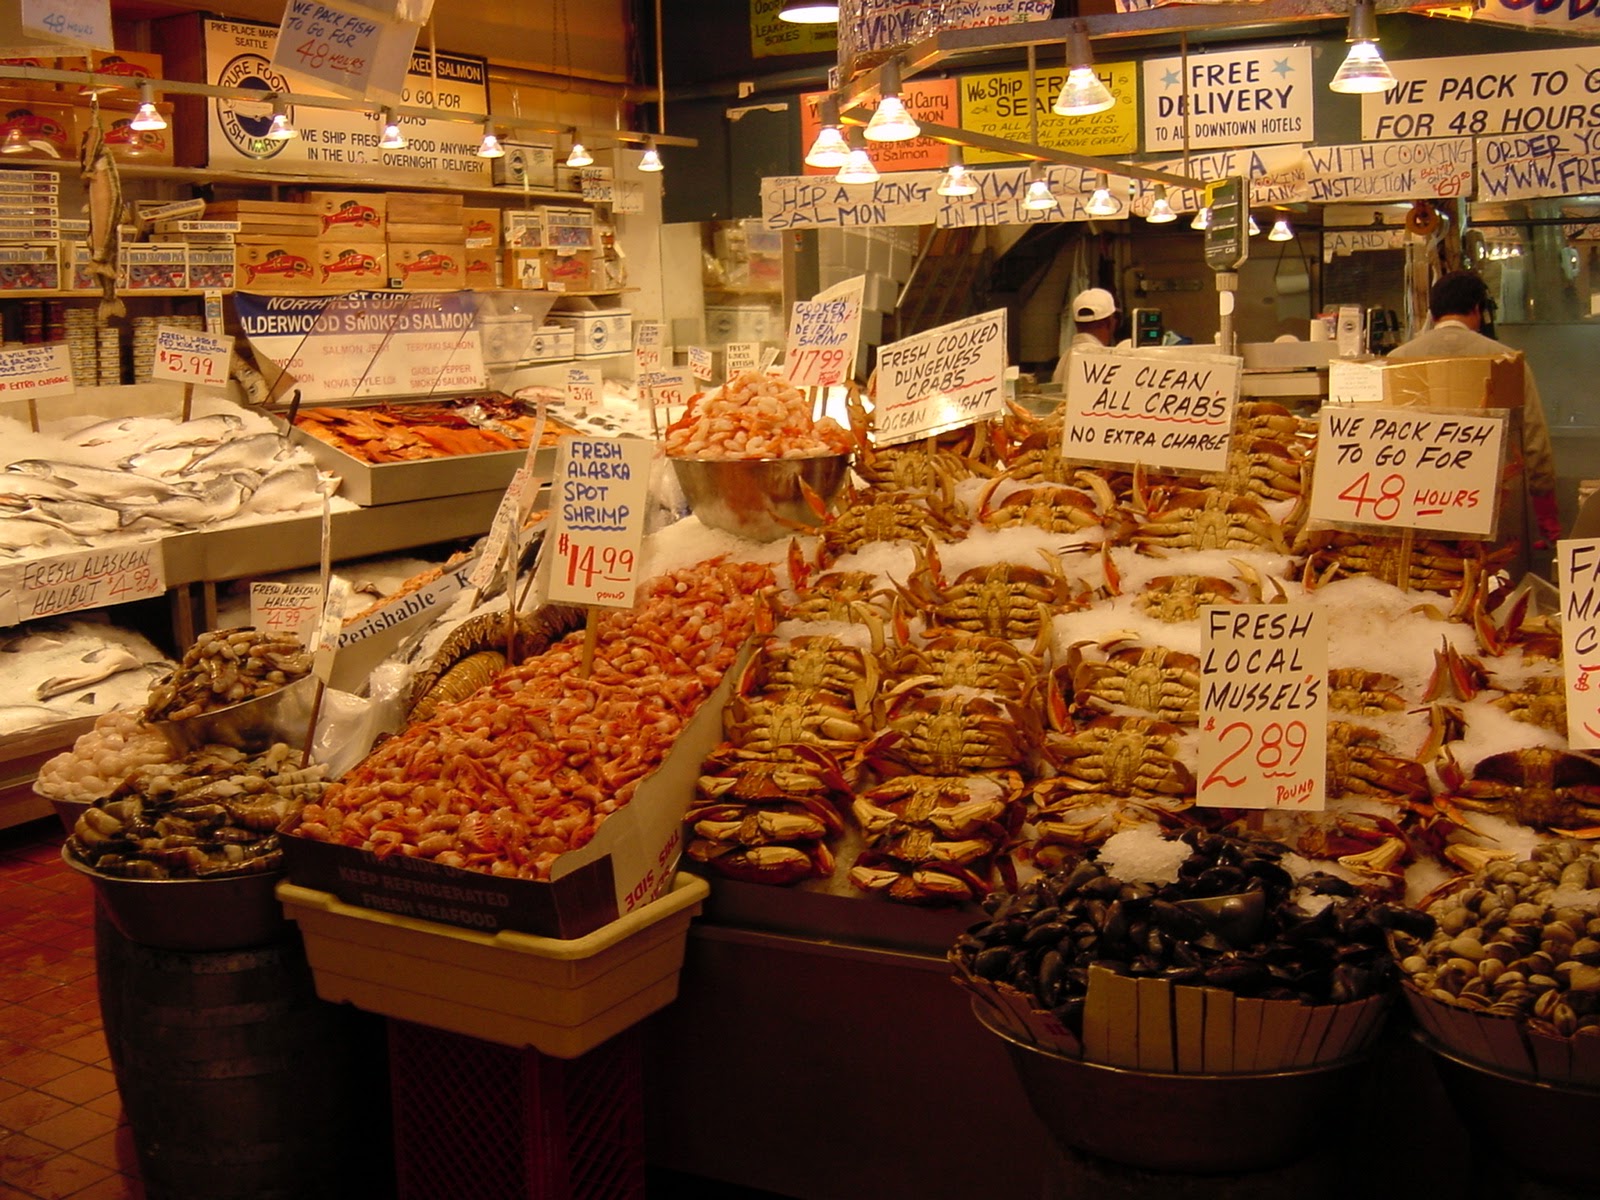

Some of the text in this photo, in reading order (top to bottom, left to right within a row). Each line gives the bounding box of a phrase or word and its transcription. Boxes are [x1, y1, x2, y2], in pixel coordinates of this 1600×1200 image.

[43, 13, 93, 35] 48 HOURS
[211, 21, 279, 39] PIKE PLACE MARK
[293, 0, 376, 36] WE PACK FISH
[235, 36, 268, 50] SEATTLE
[287, 17, 357, 48] TO GO FOR
[296, 38, 365, 69] 48 HOURS
[223, 60, 251, 88] PURE
[437, 61, 480, 81] SALMON
[1192, 60, 1260, 88] FREE
[415, 89, 461, 108] GO FOR
[967, 78, 1023, 103] We Ship
[1384, 80, 1427, 105] WE
[1439, 74, 1517, 101] PACK
[1531, 70, 1569, 96] TO
[916, 91, 949, 114] Carry
[1158, 85, 1294, 118] DELIVERY
[223, 109, 246, 145] FISH
[300, 128, 317, 142] WE
[322, 129, 346, 144] SHIP
[982, 123, 996, 133] TO
[1000, 122, 1021, 132] ALL
[1058, 125, 1119, 137] EXPRESS
[1155, 117, 1302, 141] TO DOWNTOWN HOTELS
[1375, 113, 1434, 139] FOR
[1448, 109, 1489, 134] 48
[883, 149, 928, 163] Salmon
[1055, 137, 1090, 149] ARRIVE
[1486, 134, 1570, 165] ORDER
[308, 147, 318, 160] IN
[322, 148, 343, 162] THE
[383, 153, 438, 169] OVERNIGHT
[442, 158, 484, 172] DELIVERY
[1250, 151, 1267, 179] A
[1308, 140, 1472, 174] WITH COOKING
[769, 181, 932, 215] SHIP A KING
[768, 204, 887, 229] SALMON
[940, 201, 1010, 228] IN THE
[796, 302, 847, 314] COOKED
[160, 331, 186, 341] FRESH
[241, 312, 475, 334] ALDERWOOD SMOKED SALMON
[798, 333, 848, 346] SHRIMP
[880, 322, 999, 372] FRESH COOKED
[159, 350, 213, 376] $5.99
[894, 345, 984, 387] DUNGENESS
[1083, 360, 1212, 391] WE CLEAN
[1092, 387, 1131, 411] ALL
[881, 407, 927, 432] OCEAN
[1330, 415, 1495, 446] WE PACK FISH
[571, 441, 623, 461] FRESH
[1070, 426, 1230, 452] NO EXTRA CHARGE
[1337, 443, 1473, 469] TO GO FOR
[567, 460, 631, 480] ALASKA
[564, 481, 609, 502] SPOT
[1338, 472, 1480, 521] 48 HOURS
[563, 503, 631, 525] SHRIMP
[23, 549, 150, 589] FRESH ALASKAN
[31, 580, 102, 615] HALIBUT
[252, 583, 321, 597] FRESH ALASKAN
[264, 596, 310, 608] HALIBUT
[337, 592, 437, 649] Perishable
[1210, 610, 1314, 640] FRESH
[1203, 648, 1304, 675] LOCAL
[1204, 674, 1321, 712] MUSSEL'S
[338, 865, 511, 908] KEEP REFRIGERATED
[624, 868, 655, 913] SIDE
[362, 891, 498, 928] FRESH SEAFOOD
